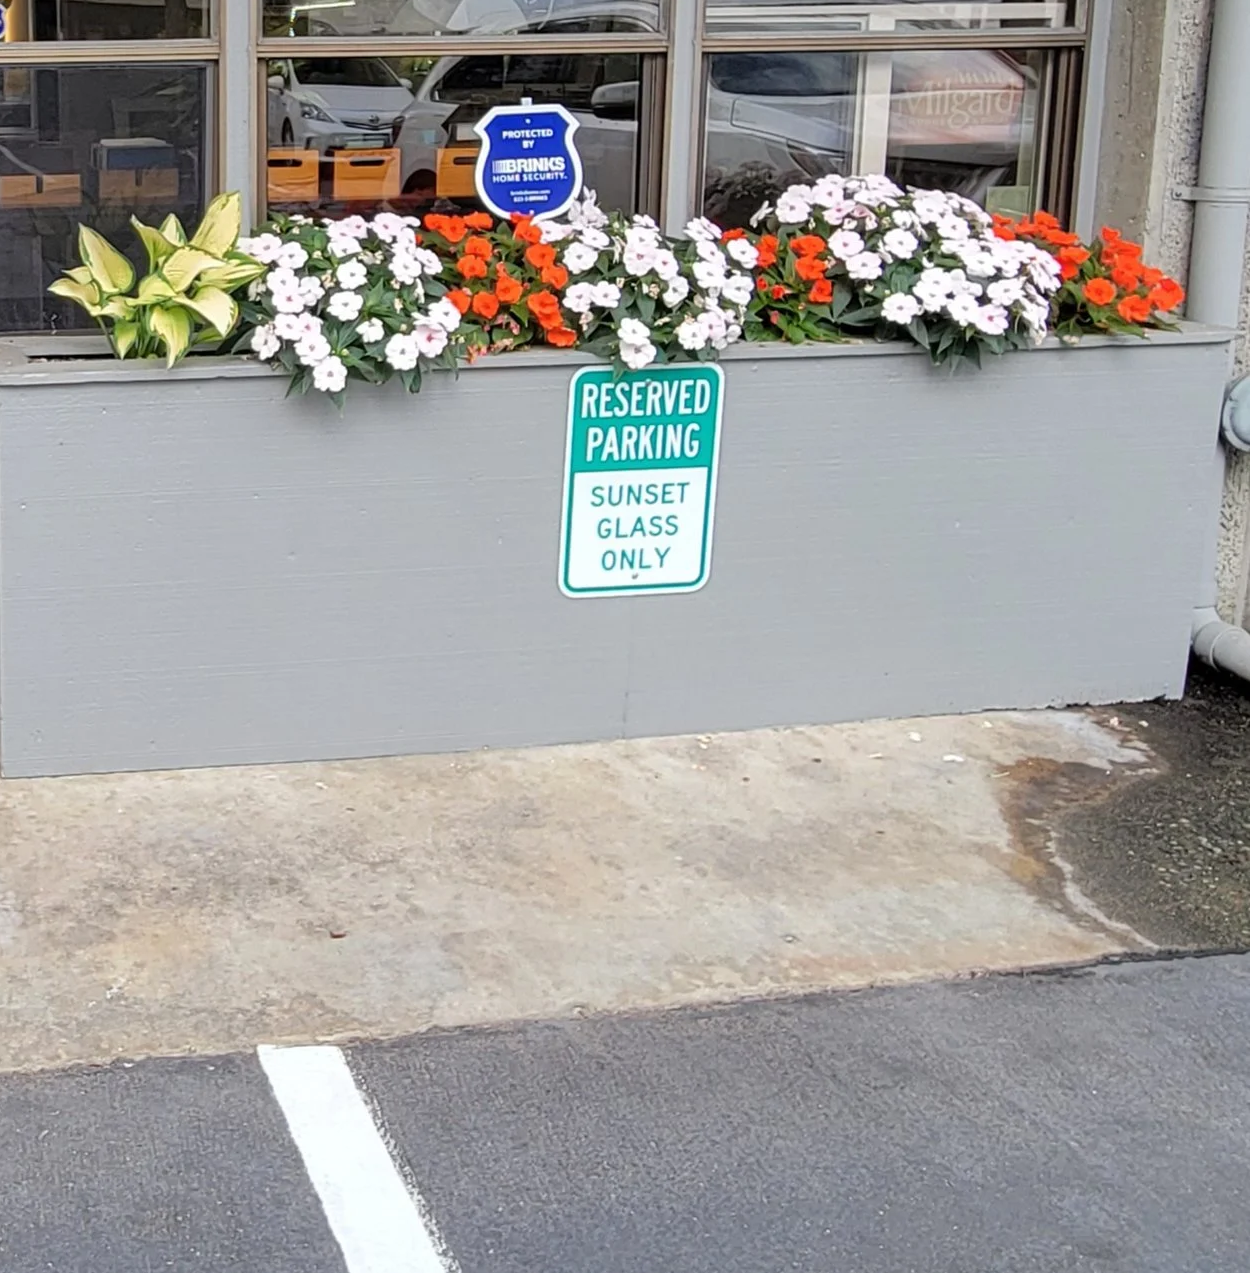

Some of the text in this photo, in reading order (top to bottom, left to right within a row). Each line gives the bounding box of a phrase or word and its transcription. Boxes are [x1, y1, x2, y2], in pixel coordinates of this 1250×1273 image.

[898, 77, 1015, 130] Milgard
[502, 129, 554, 139] PROTECTED
[522, 139, 535, 149] BY
[505, 157, 566, 174] BRINKS
[493, 174, 520, 183] HOME
[581, 379, 711, 418] RESERVED
[586, 423, 701, 462] PARKING
[590, 482, 690, 507] SUNSET
[597, 515, 679, 539] GLASS
[601, 547, 671, 571] ONLY
